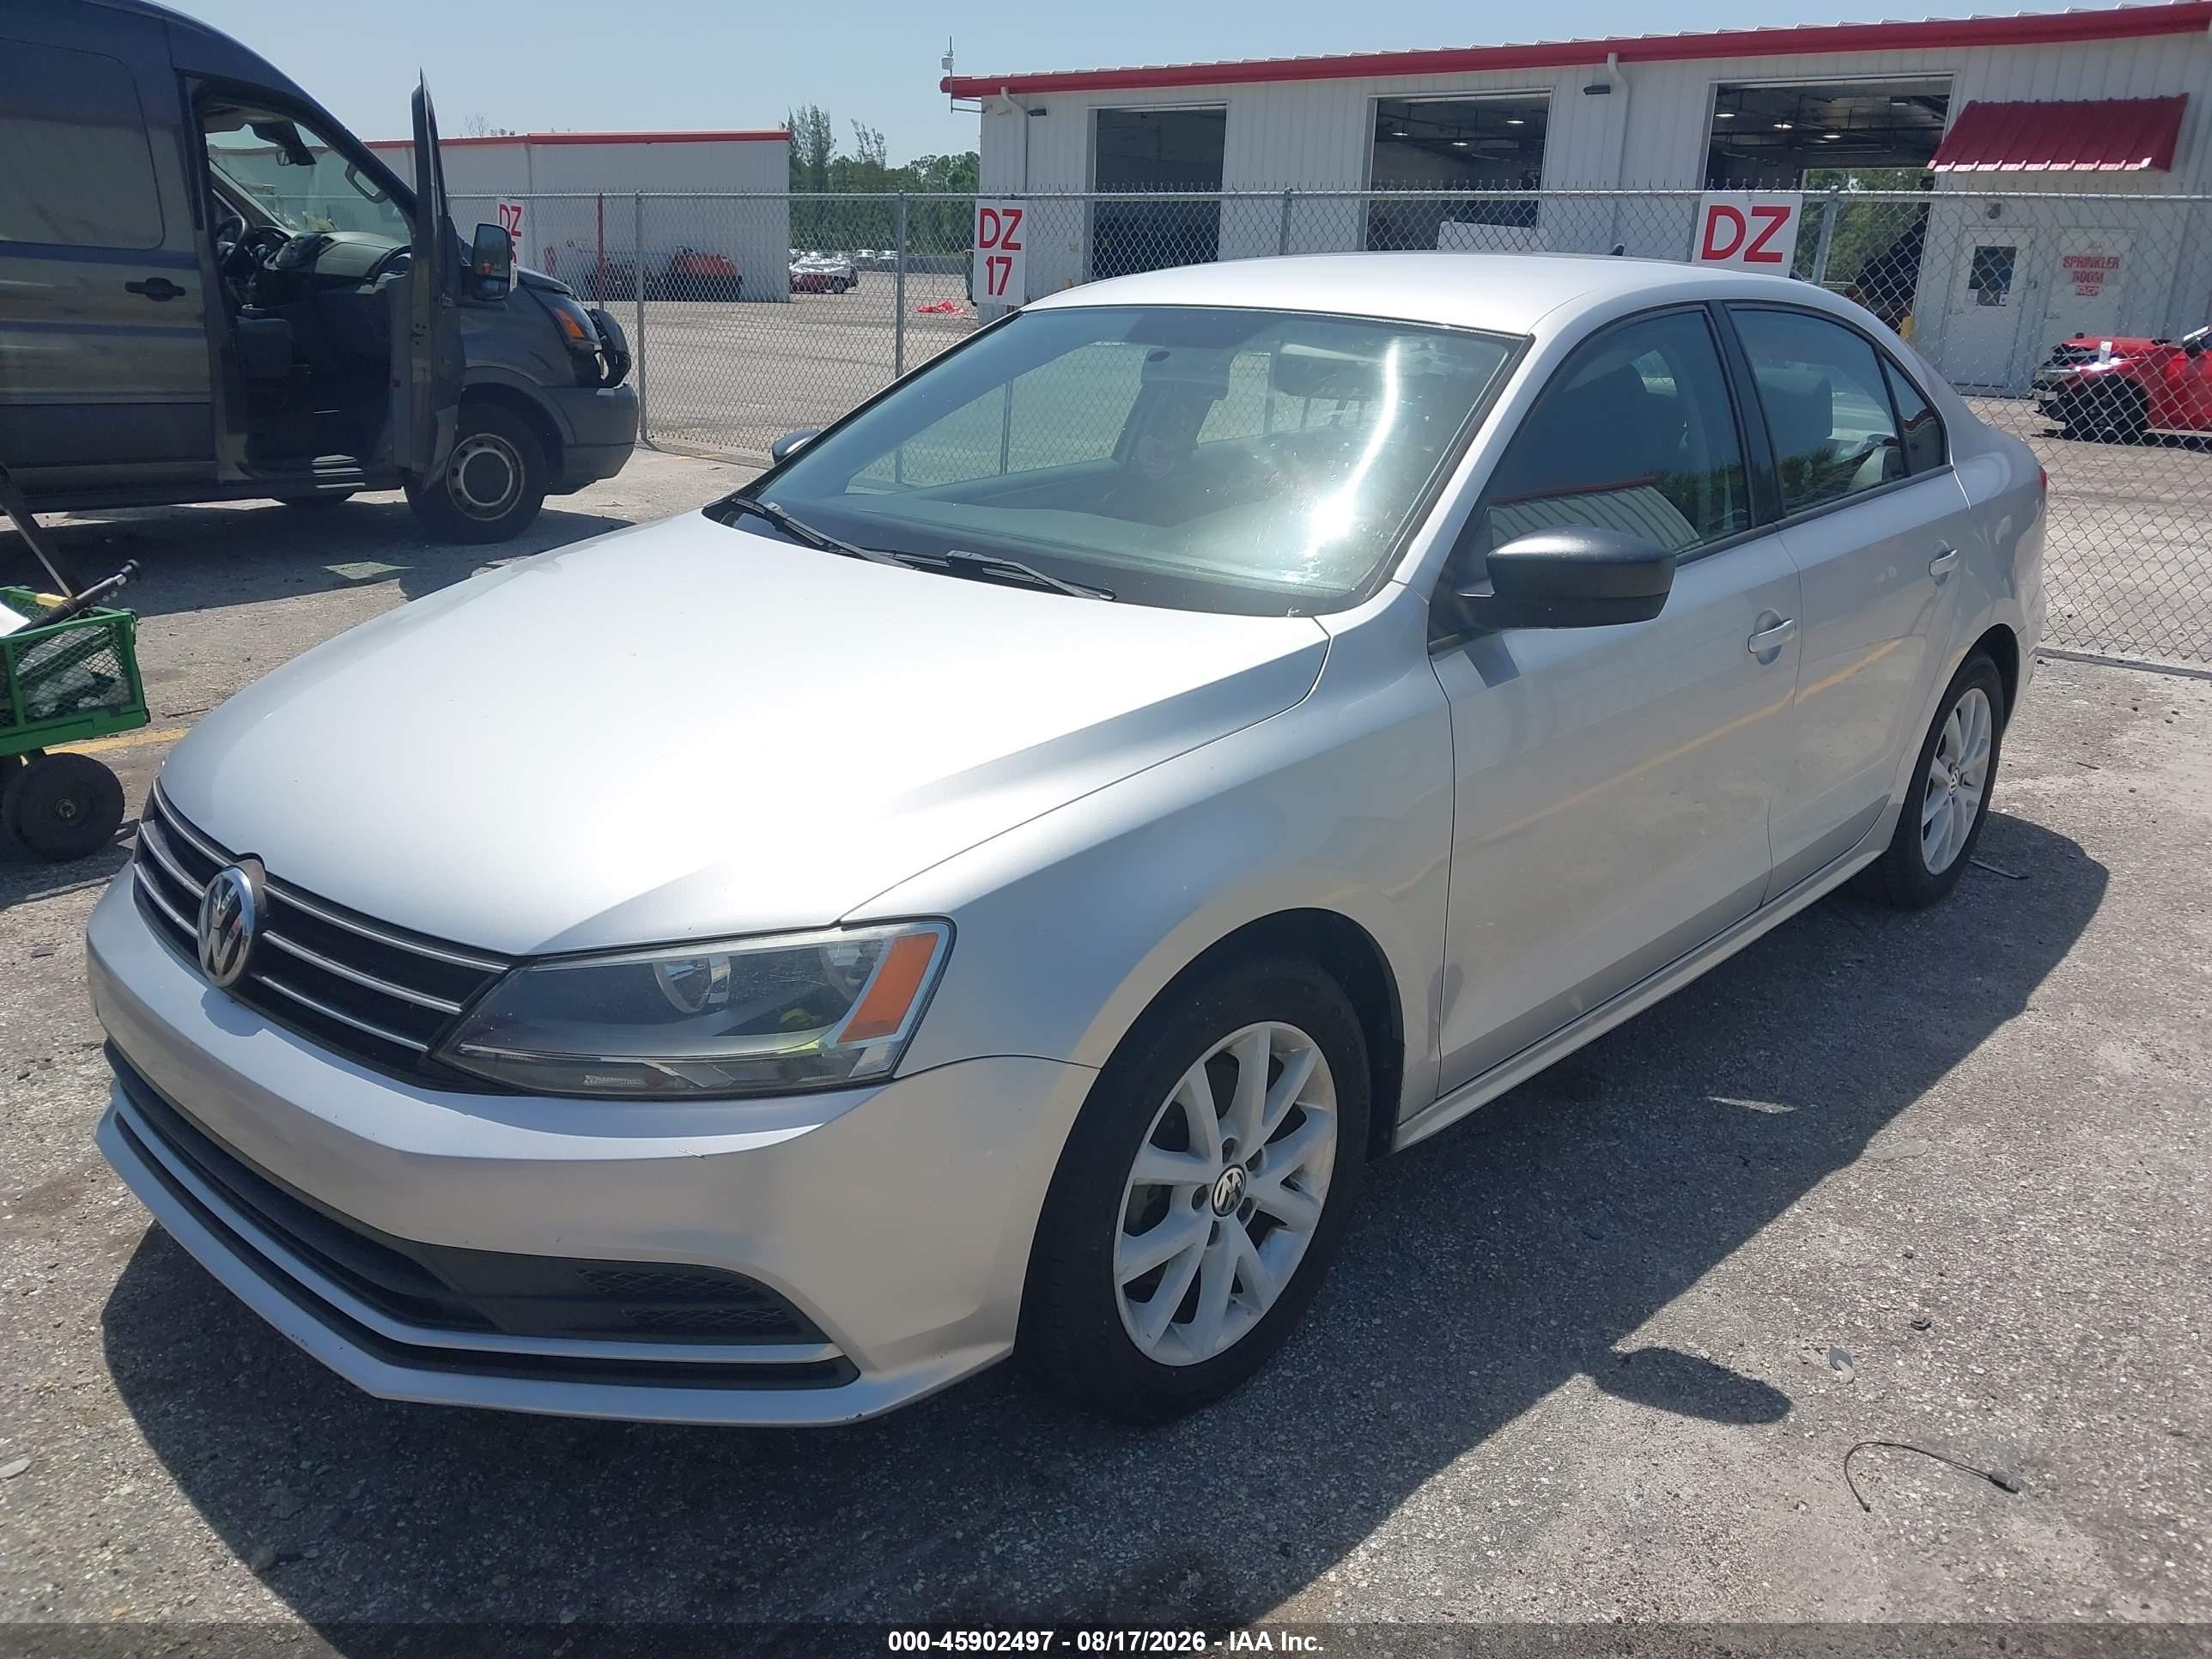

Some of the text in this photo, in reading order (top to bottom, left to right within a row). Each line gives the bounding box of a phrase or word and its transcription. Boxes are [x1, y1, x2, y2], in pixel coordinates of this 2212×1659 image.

[499, 204, 522, 237] DZ
[978, 207, 1023, 251] DZ
[1700, 204, 1792, 264] DZ
[985, 255, 1013, 296] 17
[2063, 256, 2121, 269] SPRINKLER
[2072, 270, 2106, 284] ROOM
